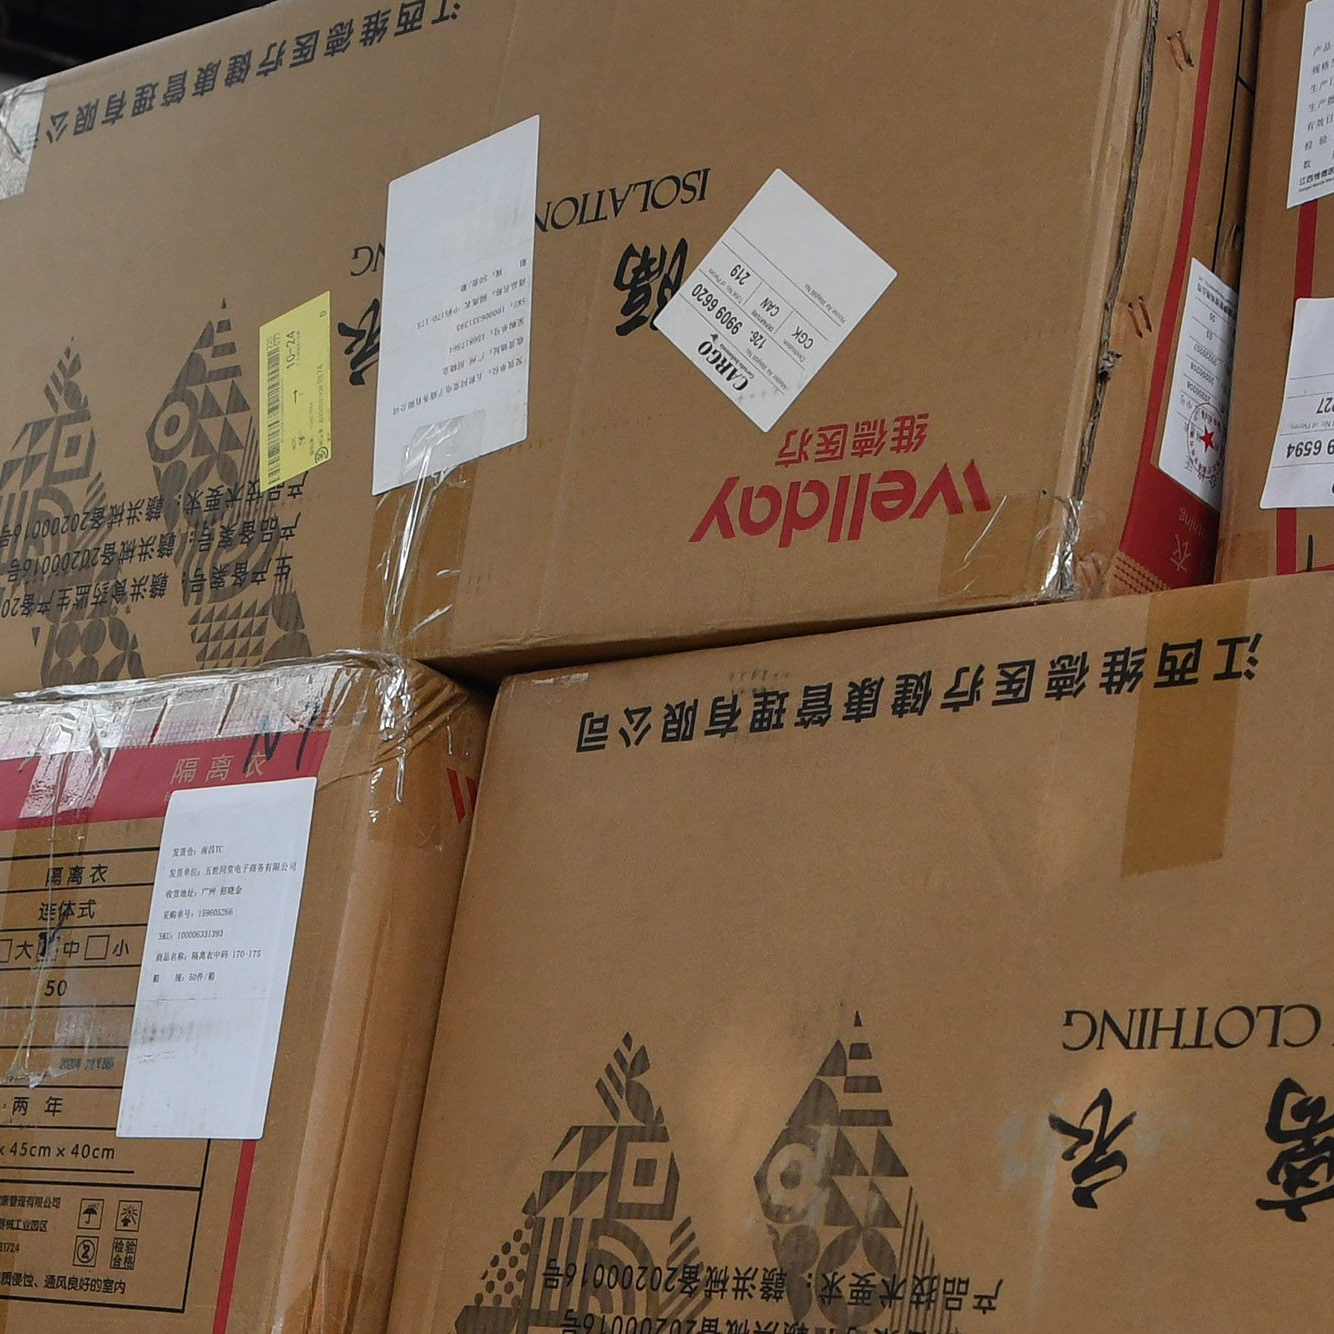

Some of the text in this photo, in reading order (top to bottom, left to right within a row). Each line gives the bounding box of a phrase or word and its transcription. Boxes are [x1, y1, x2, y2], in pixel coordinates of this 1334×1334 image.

[689, 283, 719, 314] 6620
[728, 264, 814, 349] CGK CAN 219
[713, 305, 743, 335] 9909
[284, 330, 300, 371] 10-24
[696, 338, 750, 391] CARGO
[775, 412, 930, 469] 维德医疗
[1286, 439, 1322, 458] 6594
[689, 459, 992, 548] wellday
[576, 631, 1263, 753] 江西维德医疗健康管理有限公司
[44, 863, 108, 887] 隔离衣
[37, 899, 97, 923] 连体式
[44, 978, 68, 998] 50
[1062, 1002, 1322, 1052] CLOTHING
